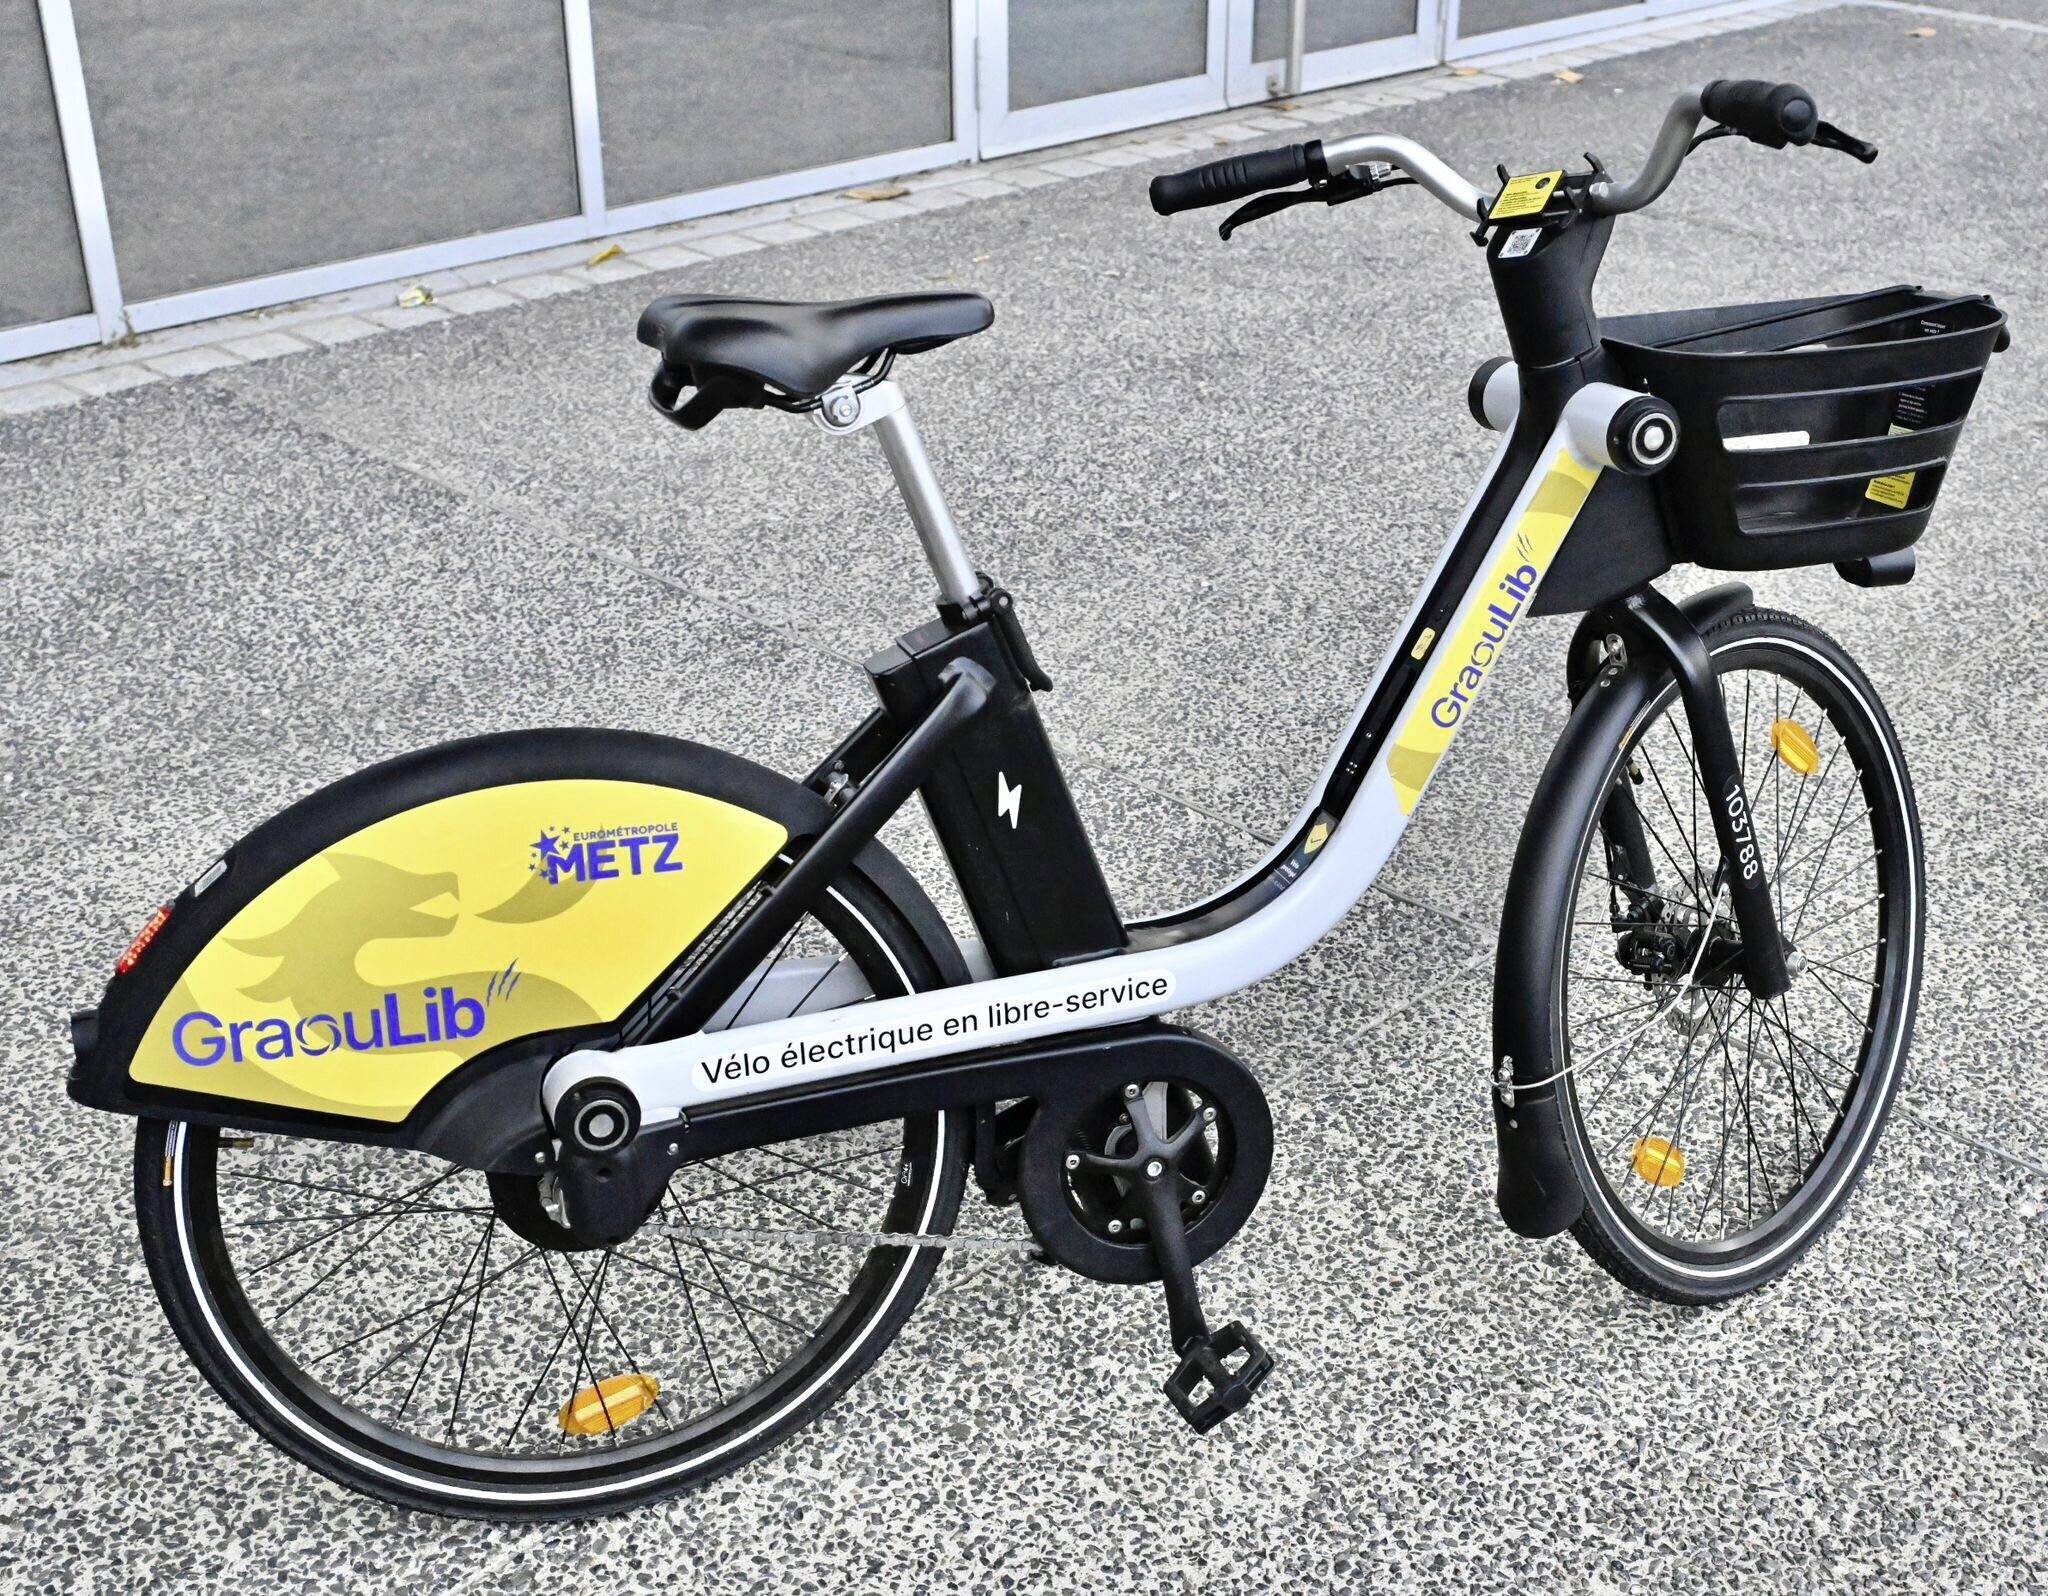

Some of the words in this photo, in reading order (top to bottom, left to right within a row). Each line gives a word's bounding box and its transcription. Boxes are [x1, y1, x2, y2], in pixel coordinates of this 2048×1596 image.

[1431, 564, 1537, 728] GraouLib
[547, 833, 683, 885] METZ
[573, 822, 678, 842] EUROMÉTROPOLE
[1725, 784, 1758, 880] 103788
[172, 987, 487, 1068] GraouLib
[701, 1053, 770, 1084] Vélo
[780, 1027, 933, 1069] électrique
[943, 1015, 978, 1037] en
[988, 977, 1168, 1028] libre-service
